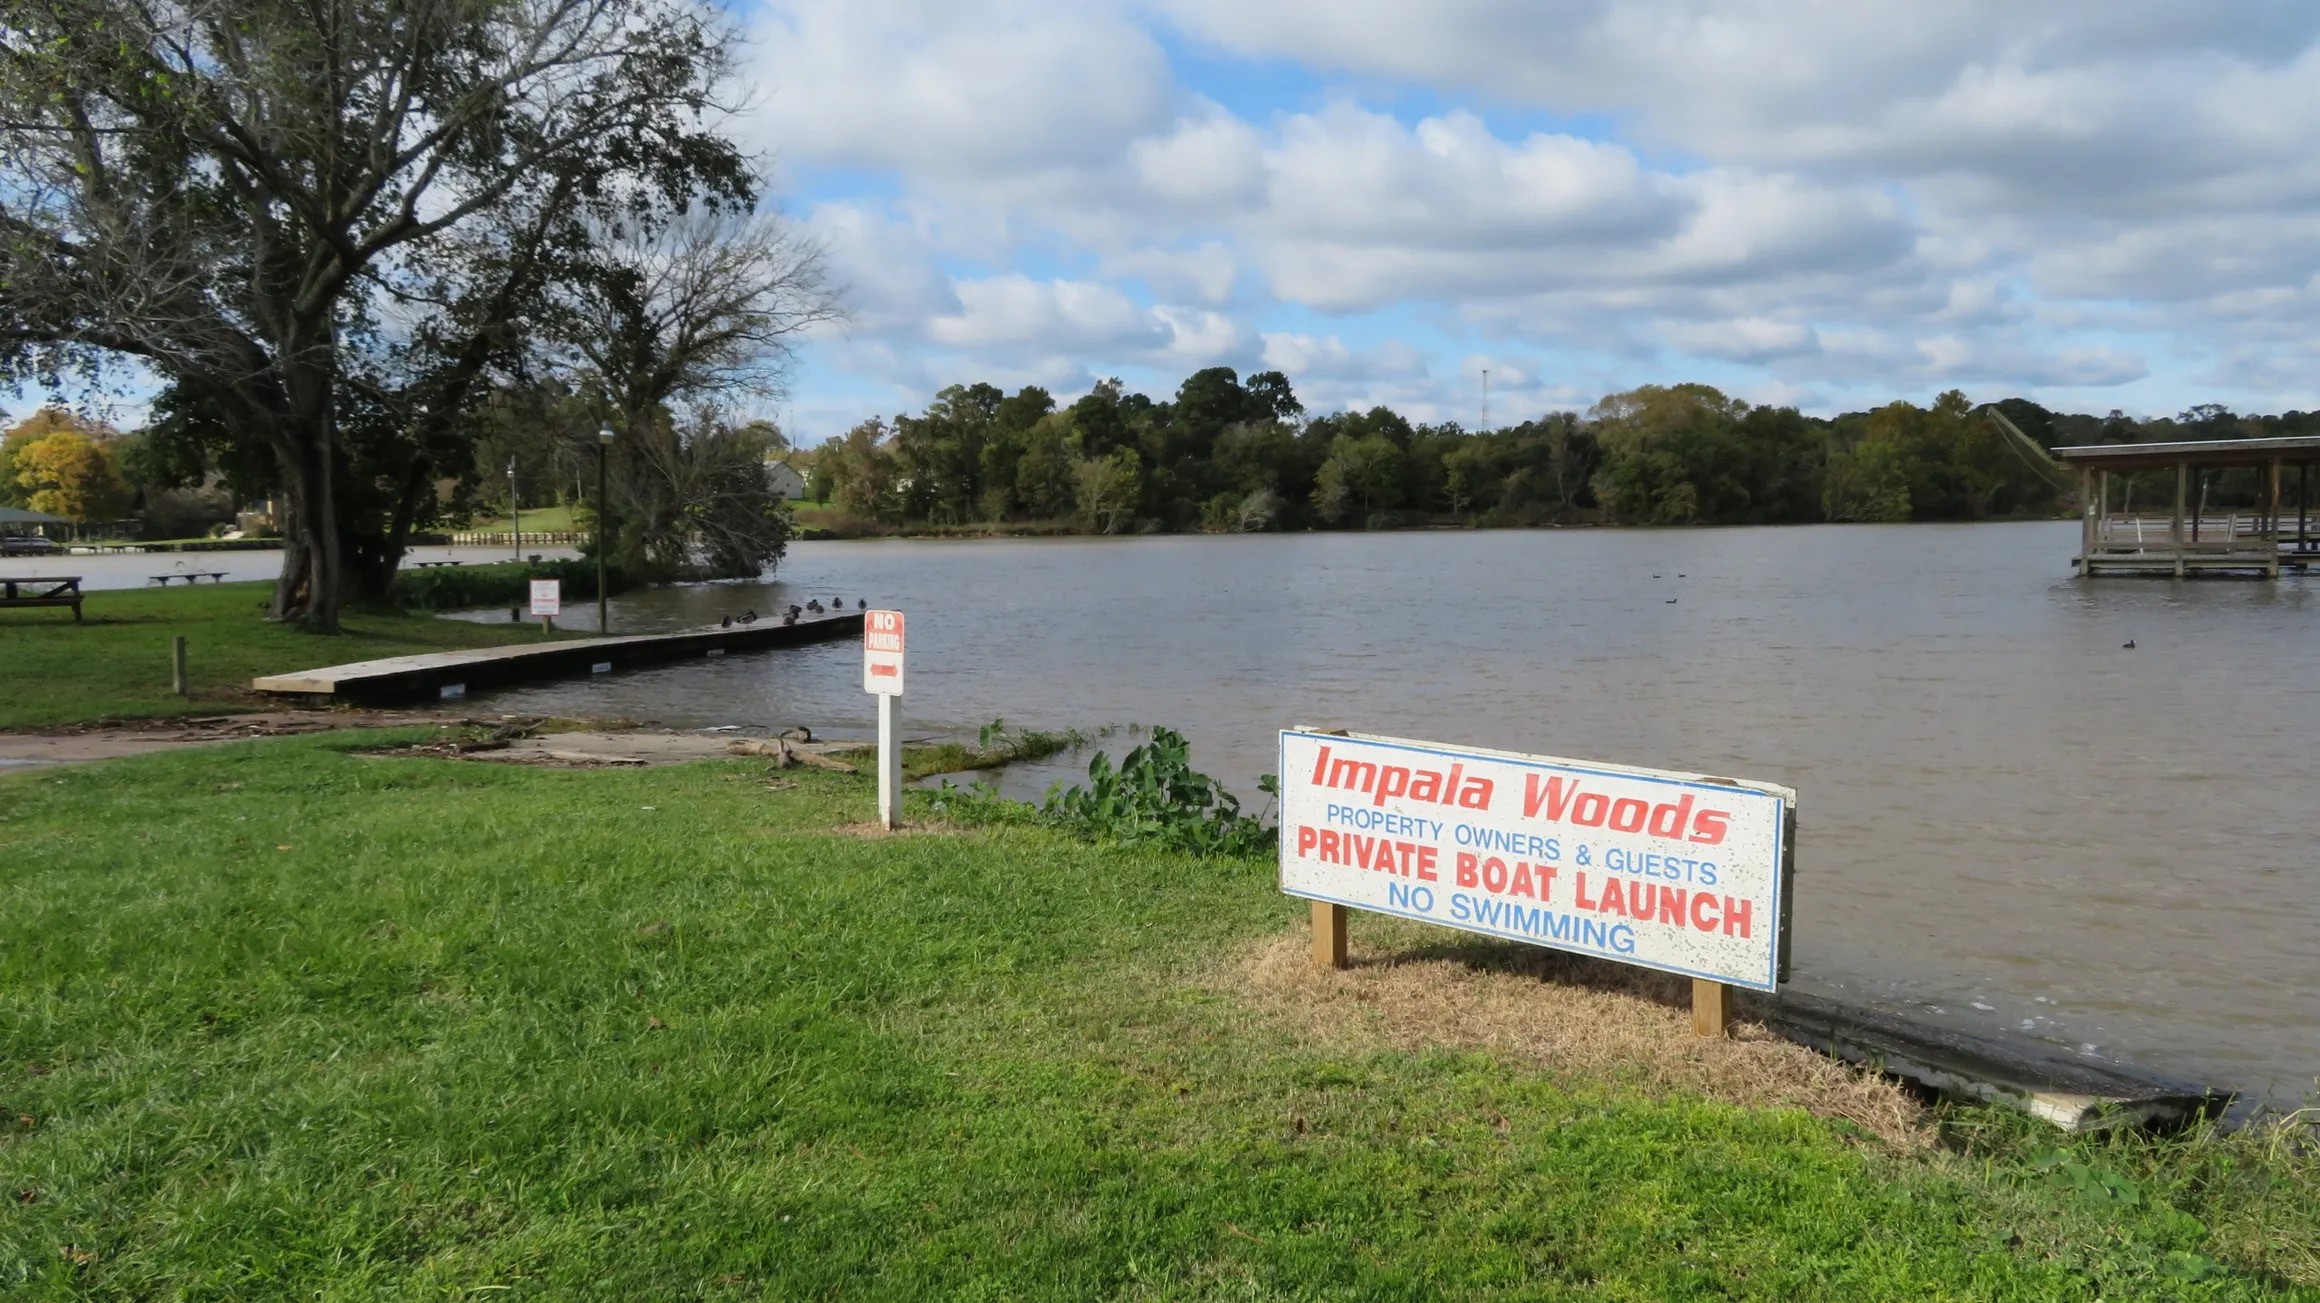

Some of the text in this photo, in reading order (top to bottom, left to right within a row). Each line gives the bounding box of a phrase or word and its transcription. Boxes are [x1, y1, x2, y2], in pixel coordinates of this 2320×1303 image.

[868, 632, 900, 650] PARKING
[874, 613, 896, 630] NO
[1311, 745, 1731, 845] Impala Woods
[1298, 825, 1753, 939] PRIVATE BOAT LAUNCH
[1327, 804, 1718, 886] PROPERTY OWNERS & GUESTS
[1389, 881, 1635, 953] NO SWIMMING
